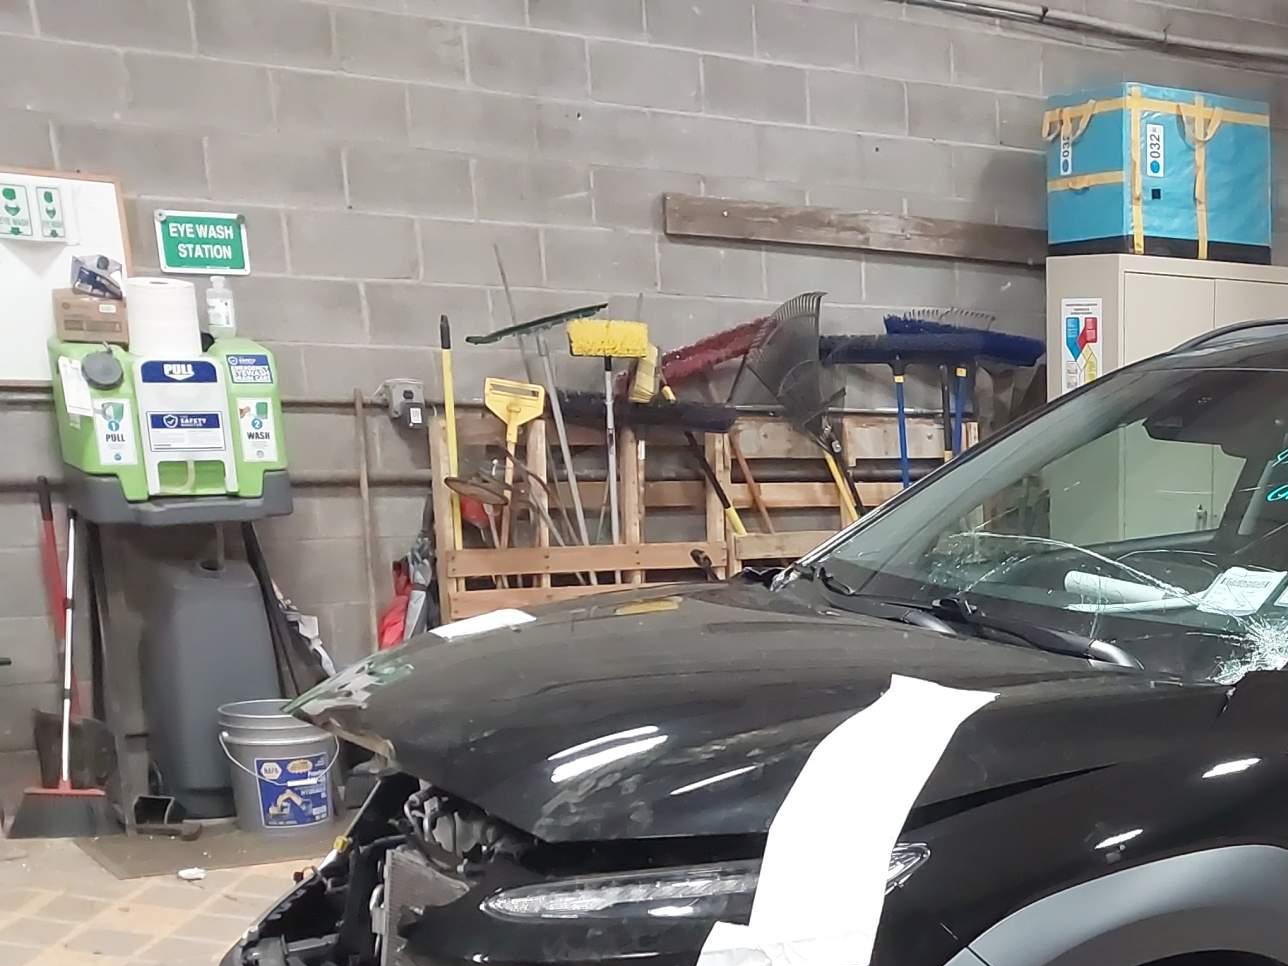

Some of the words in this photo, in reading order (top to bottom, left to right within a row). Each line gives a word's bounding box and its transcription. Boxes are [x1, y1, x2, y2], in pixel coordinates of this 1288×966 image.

[168, 222, 195, 238] EYE
[195, 223, 234, 240] WASH
[177, 243, 233, 260] STATION
[163, 363, 194, 376] PULL
[105, 433, 126, 442] PULL
[246, 431, 271, 440] WASH
